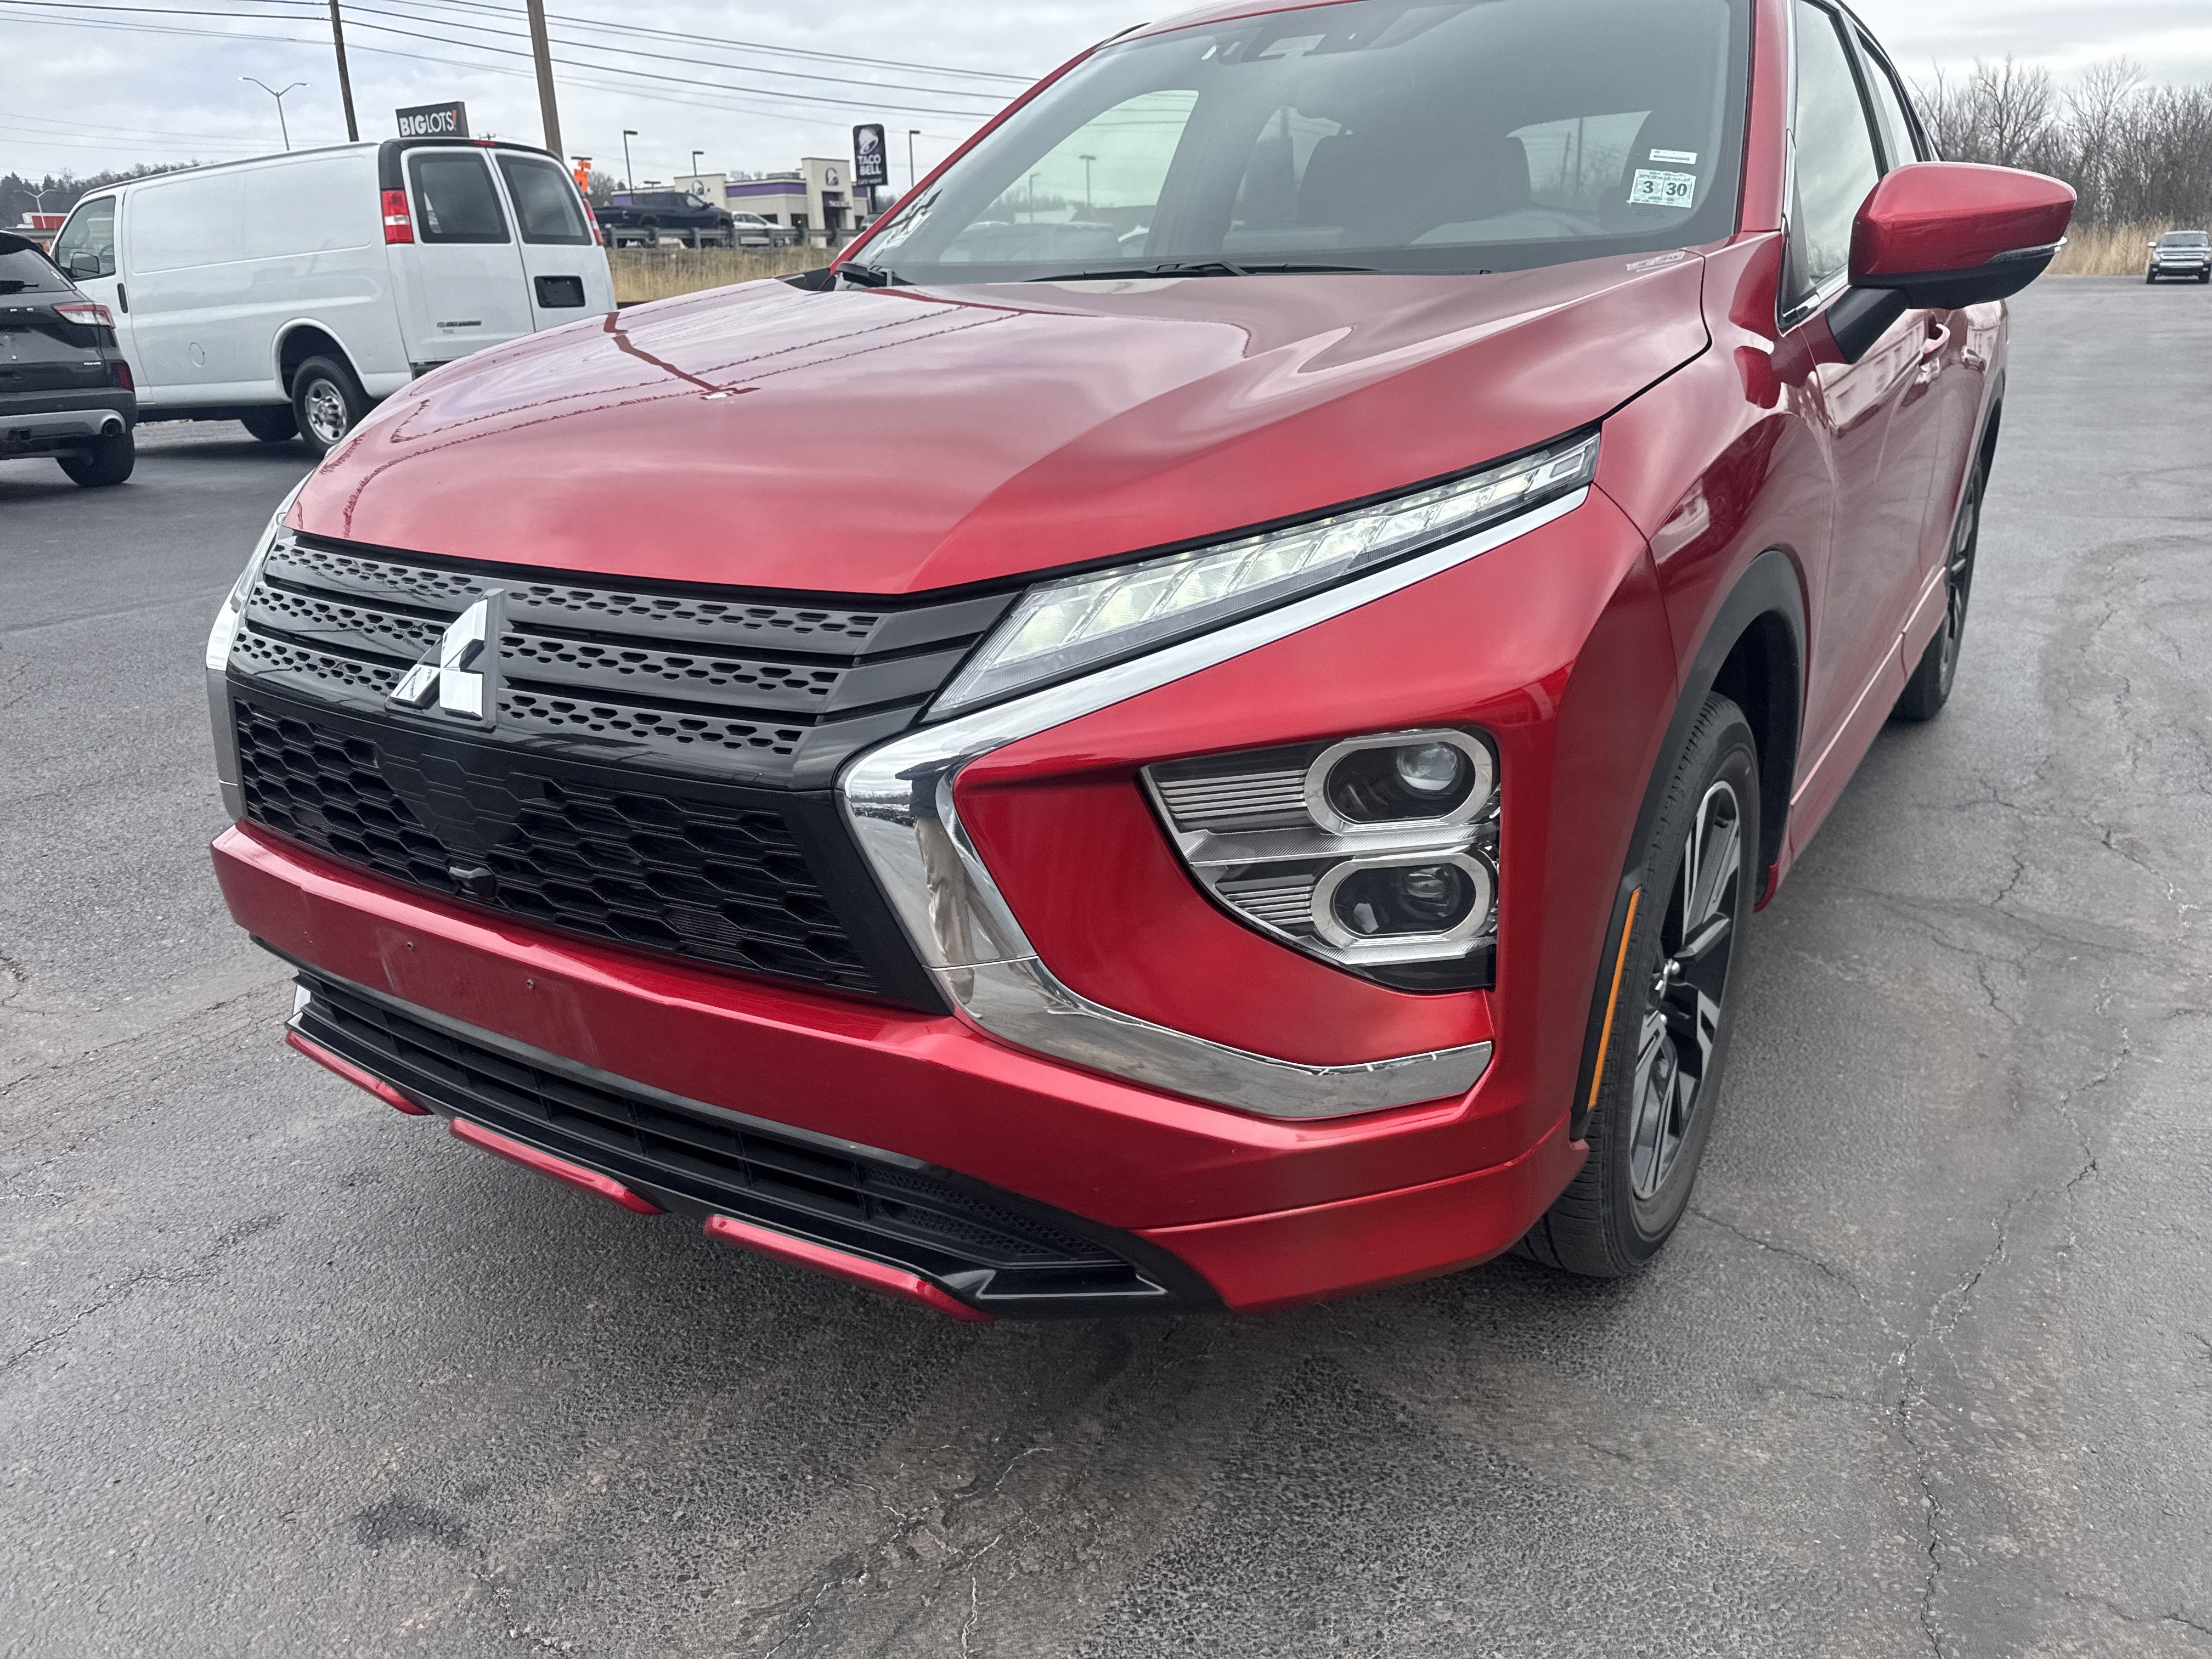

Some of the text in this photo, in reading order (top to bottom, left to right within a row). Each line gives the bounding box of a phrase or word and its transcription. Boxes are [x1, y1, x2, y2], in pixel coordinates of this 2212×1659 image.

[857, 154, 882, 165] TACO
[859, 164, 882, 176] BELL
[1643, 180, 1688, 197] 3 30
